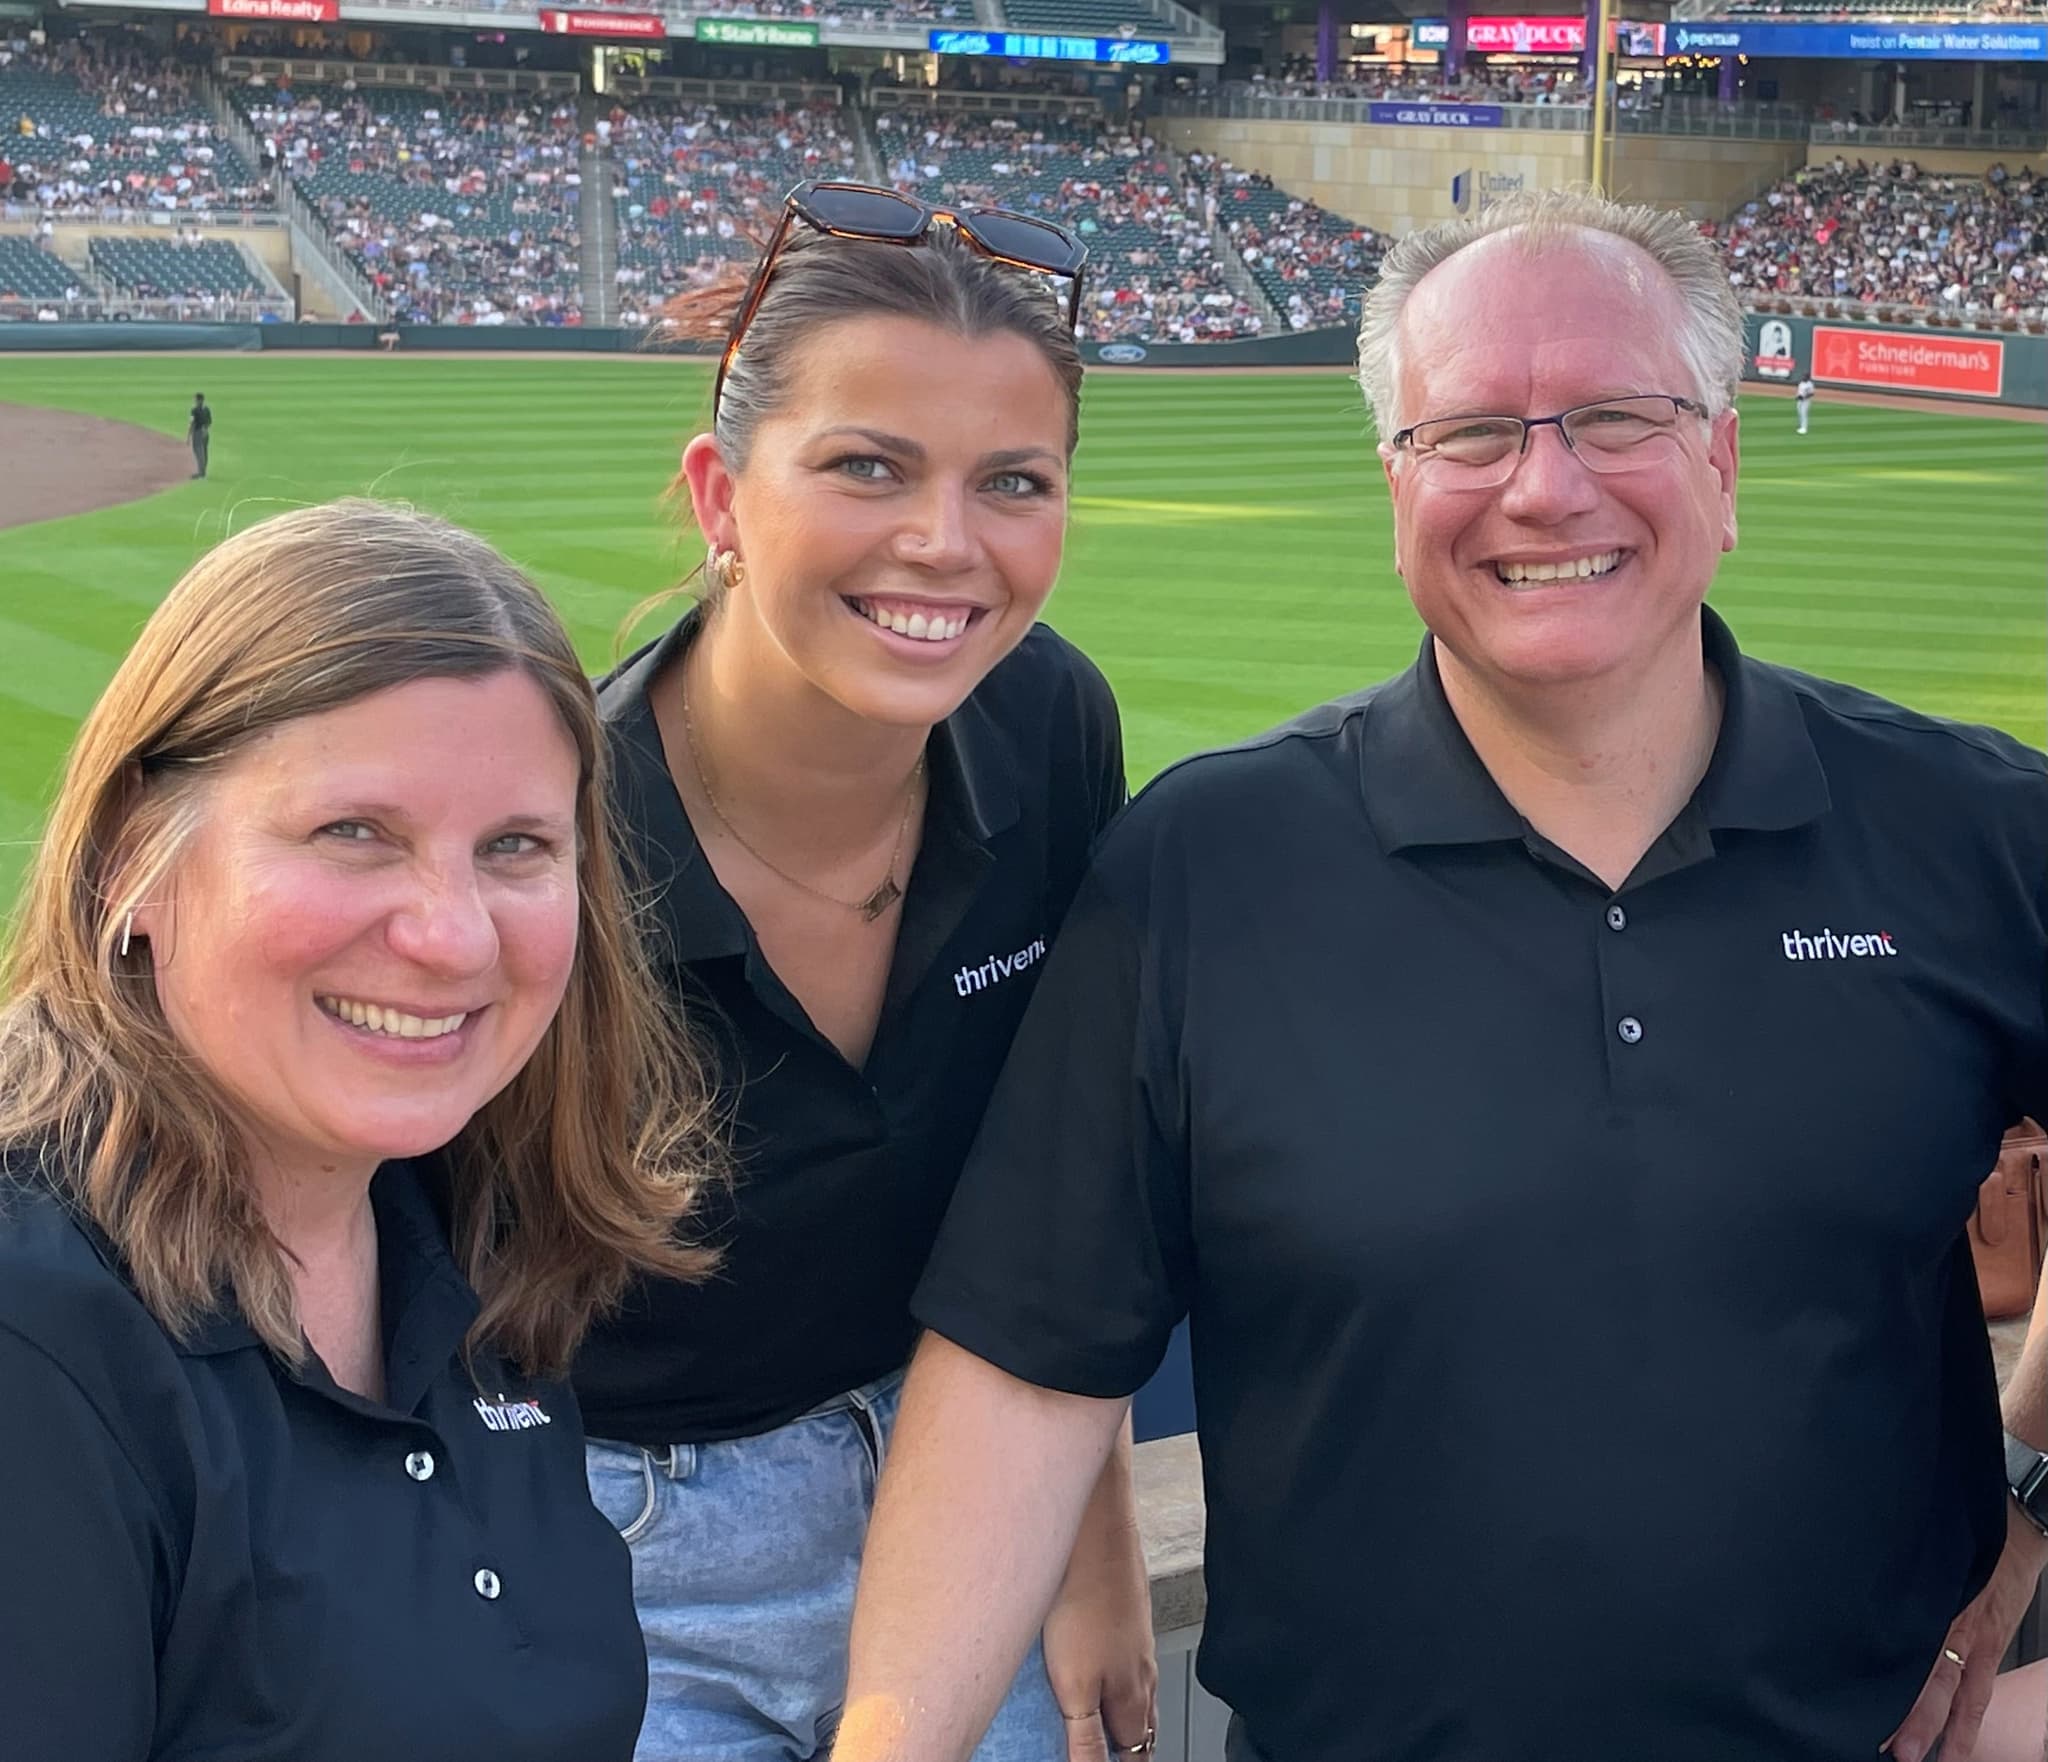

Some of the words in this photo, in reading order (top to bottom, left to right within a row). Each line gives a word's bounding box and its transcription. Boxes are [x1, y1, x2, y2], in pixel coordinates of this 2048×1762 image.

[222, 0, 270, 13] Edina
[270, 0, 324, 21] Realty
[1467, 26, 1520, 44] GRAY
[1526, 26, 1582, 44] DUCK
[1981, 34, 2040, 49] Solutions
[1479, 171, 1524, 192] United
[1858, 340, 1990, 371] Schneiderman's
[1782, 928, 1897, 960] thrivent
